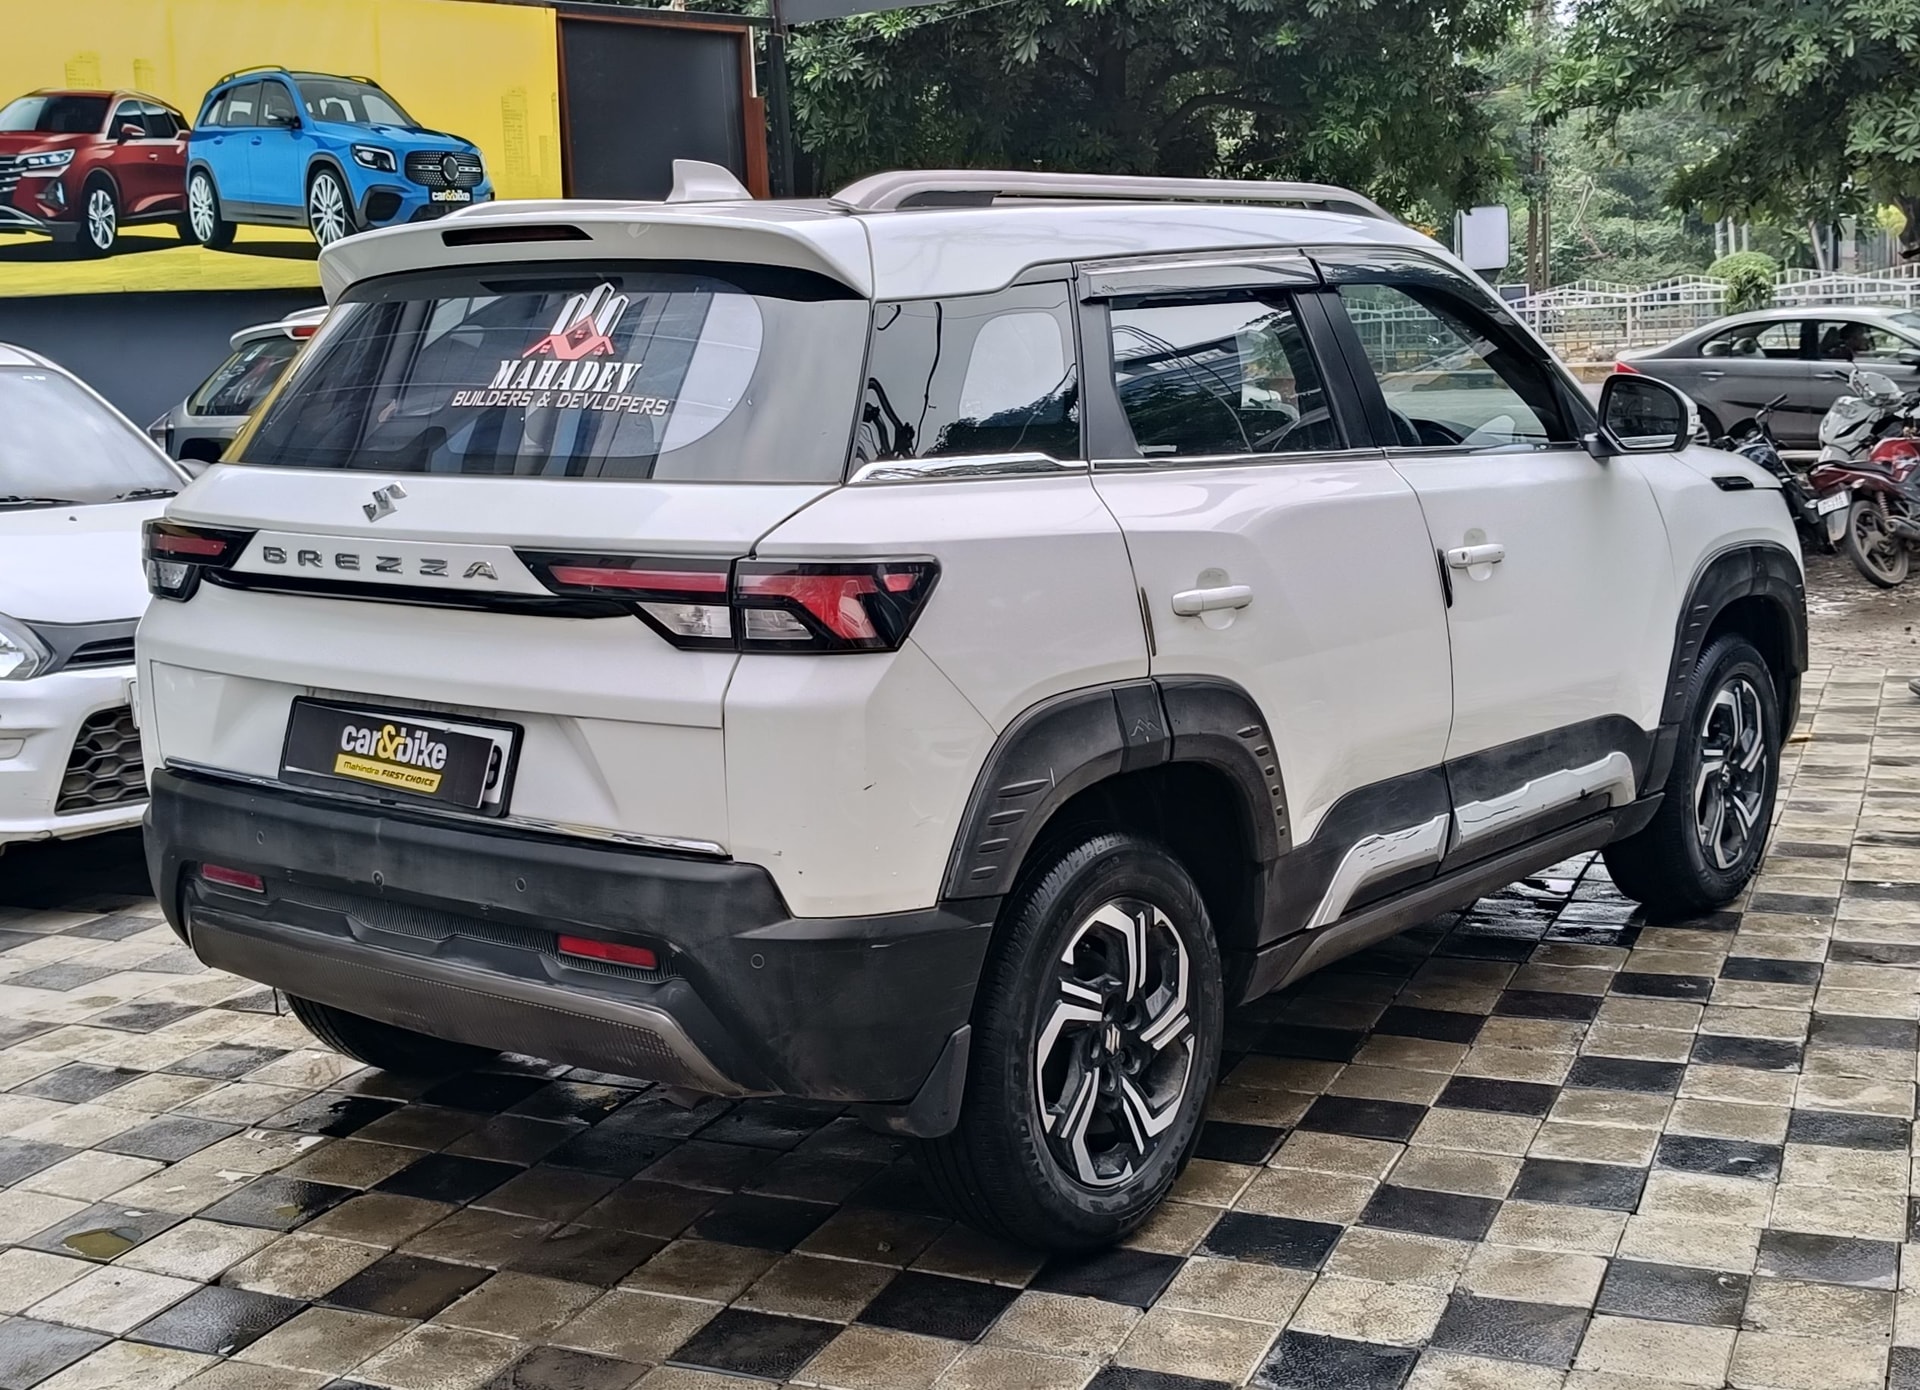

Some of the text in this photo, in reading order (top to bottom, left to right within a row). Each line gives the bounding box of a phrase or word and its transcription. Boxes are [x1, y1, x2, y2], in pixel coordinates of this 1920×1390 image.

[488, 360, 643, 394] MAHADEV
[451, 390, 670, 417] BUILDERS & DEVLOPERS
[262, 545, 499, 581] BREZZA
[341, 724, 447, 770] car&bike
[382, 769, 405, 780] FIRST
[406, 774, 435, 786] CHOICE
